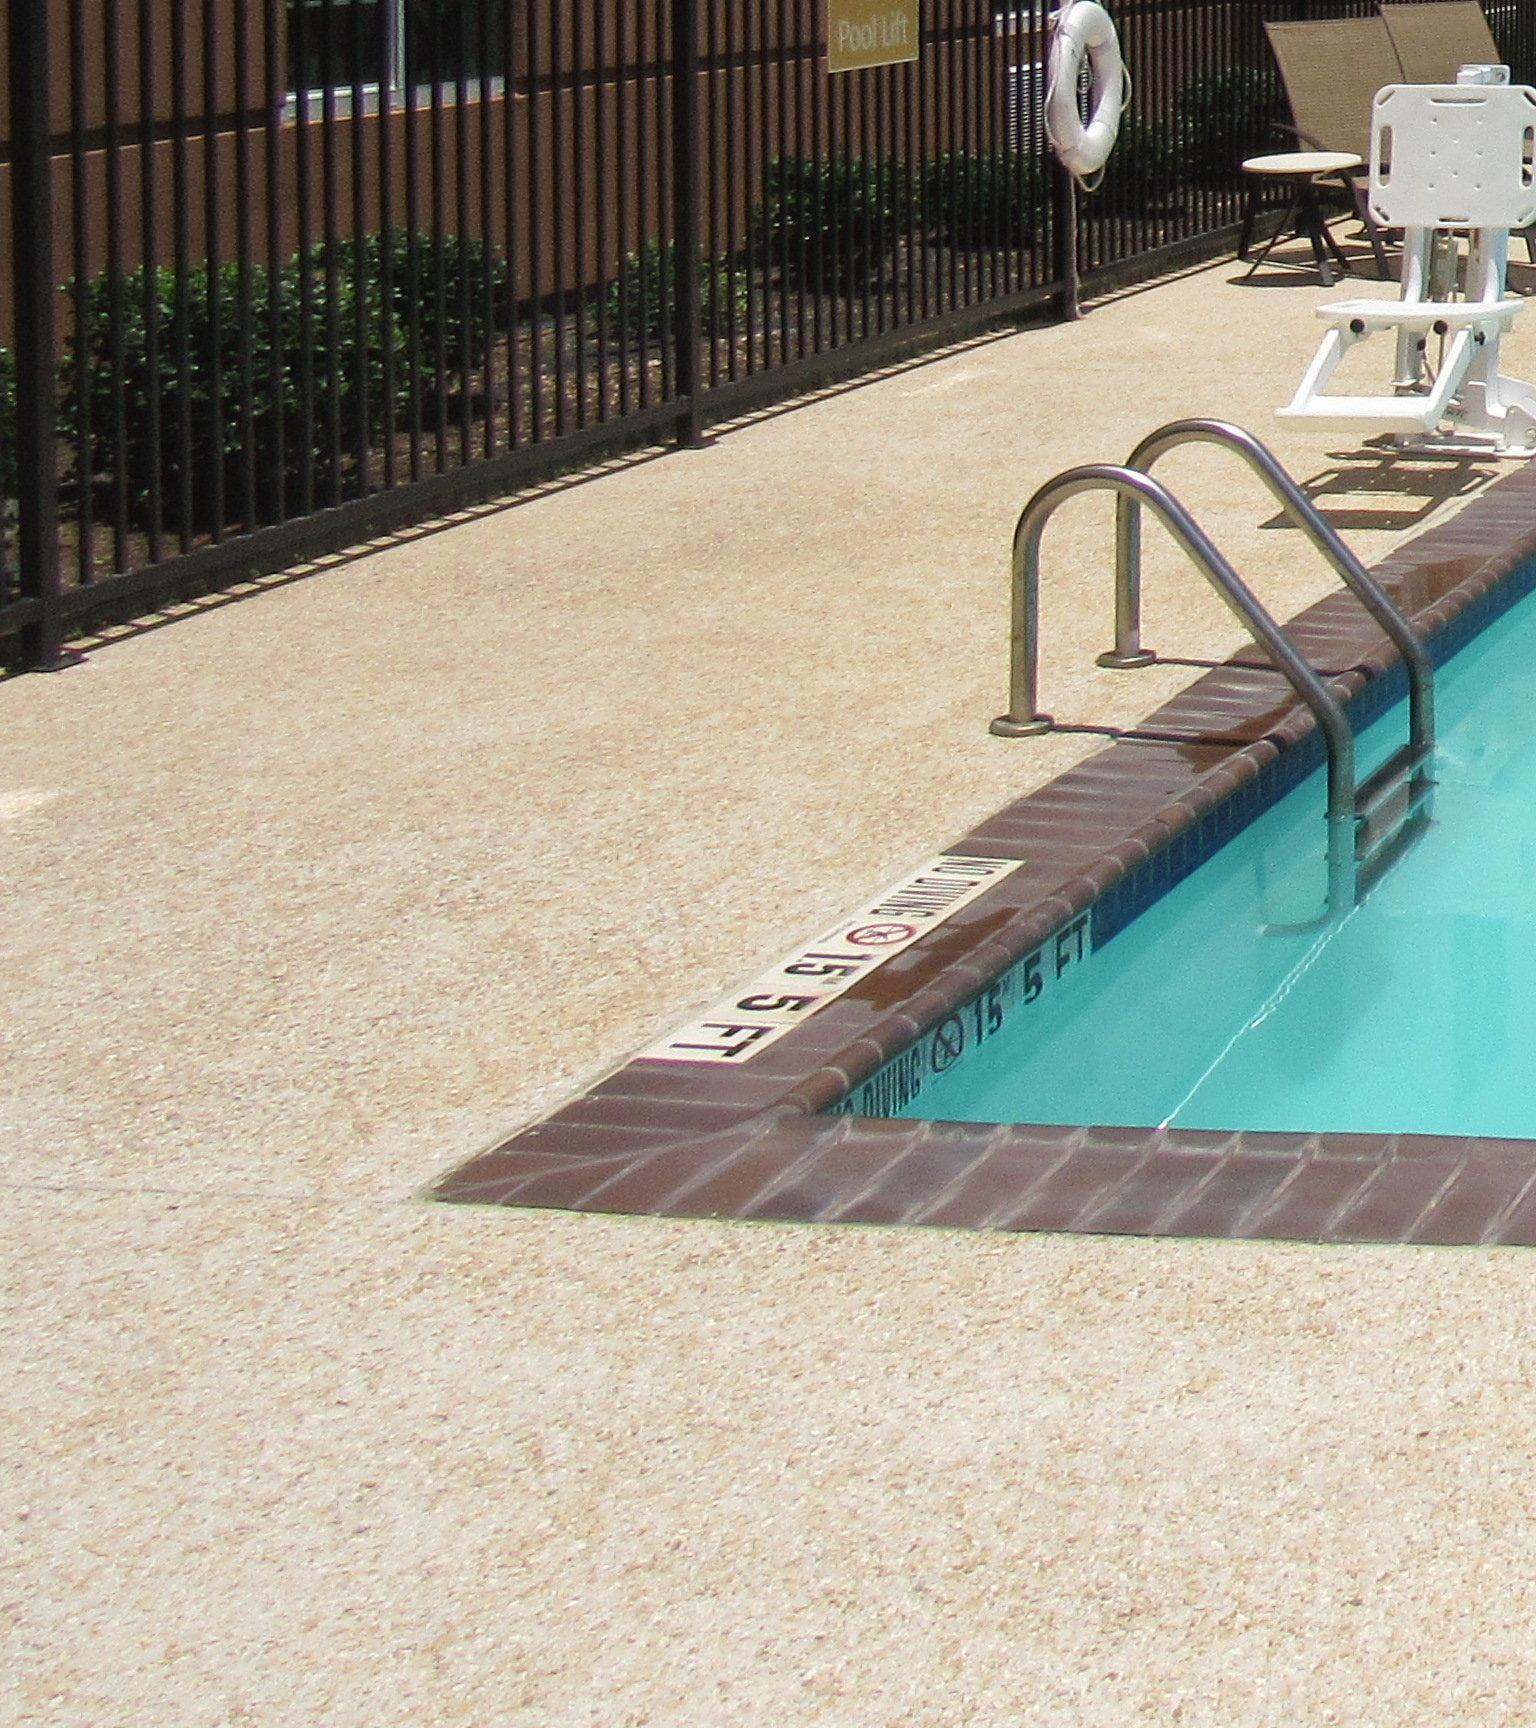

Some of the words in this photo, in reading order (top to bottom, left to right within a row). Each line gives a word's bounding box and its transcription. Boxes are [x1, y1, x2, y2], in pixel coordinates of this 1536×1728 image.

[868, 877, 981, 918] DIVING
[1022, 951, 1044, 1006] 5
[1055, 912, 1089, 981] FT
[736, 993, 820, 1012] 5
[669, 1022, 777, 1058] FT
